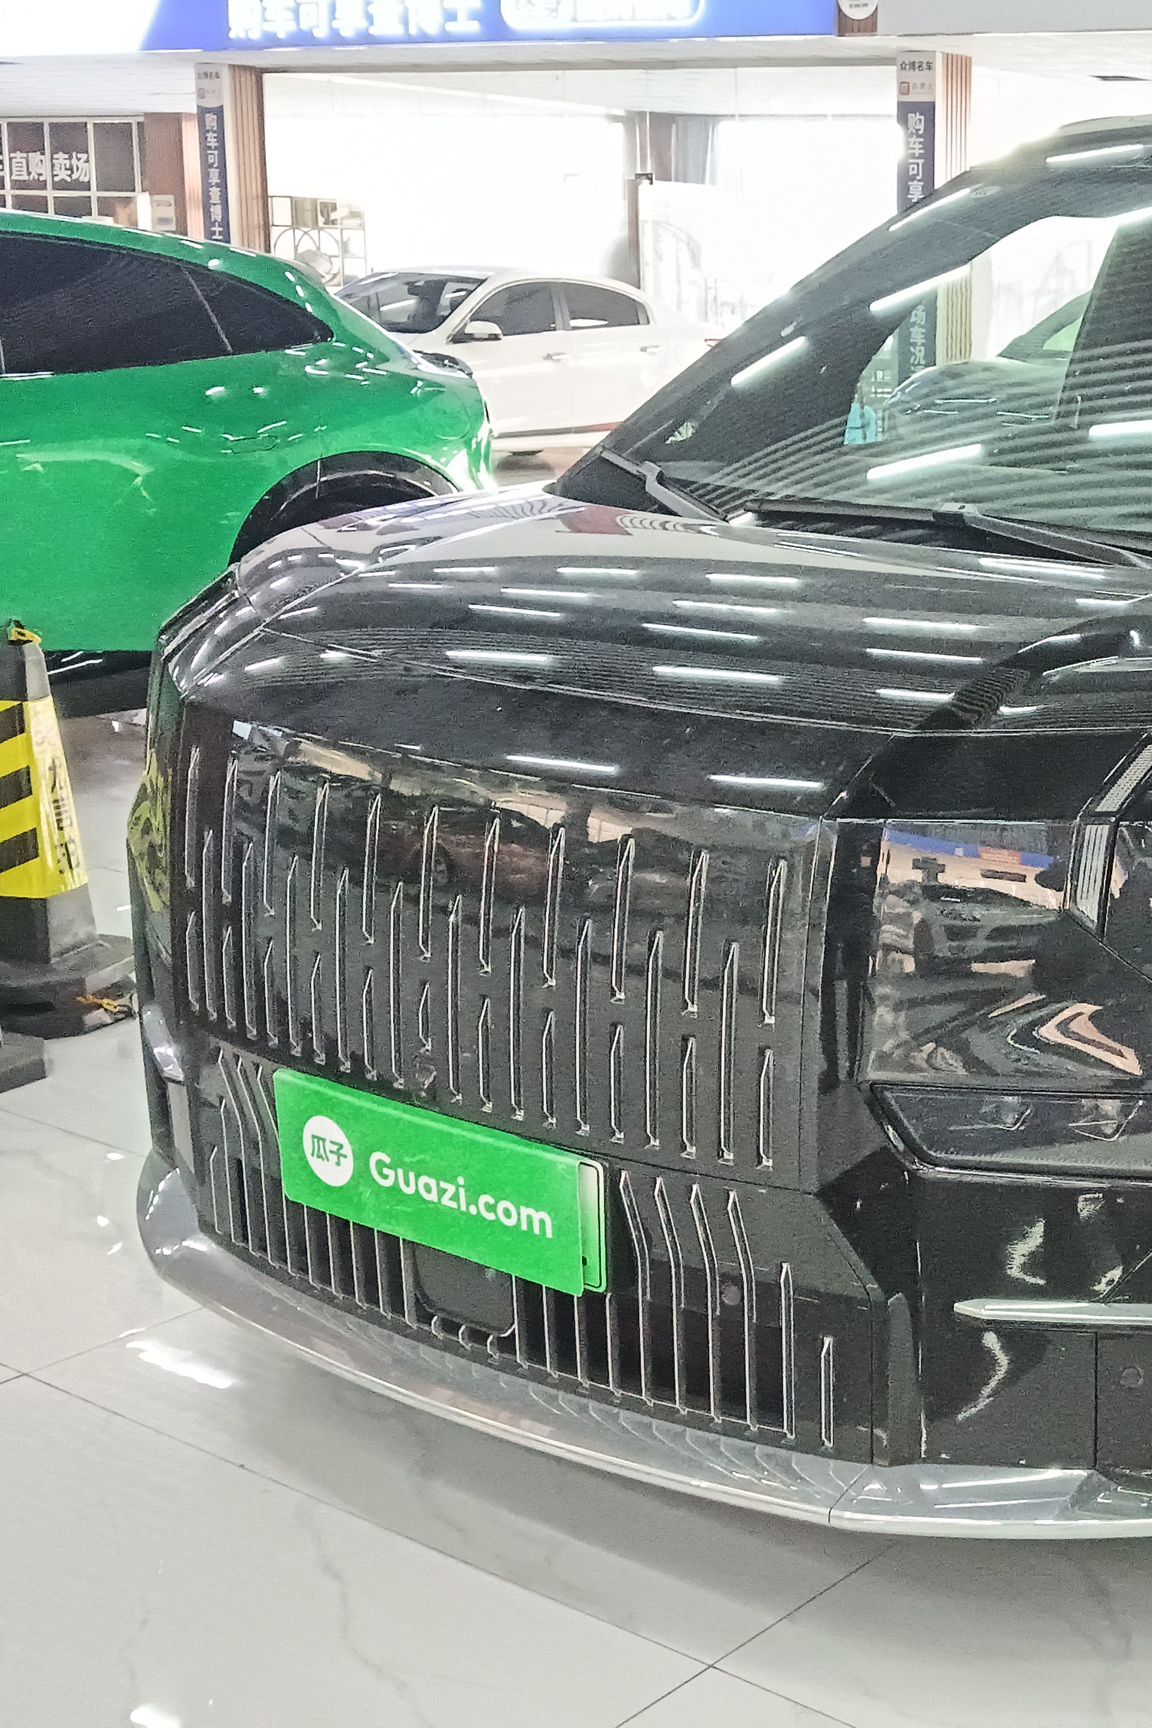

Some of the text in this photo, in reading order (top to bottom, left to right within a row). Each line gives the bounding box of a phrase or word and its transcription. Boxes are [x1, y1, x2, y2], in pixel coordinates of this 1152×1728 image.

[900, 60, 934, 72] 众博名车
[204, 112, 224, 241] 购车可享查博士
[906, 111, 925, 203] 购车可享
[310, 1133, 553, 1239] 瓜子 Guazi.com
